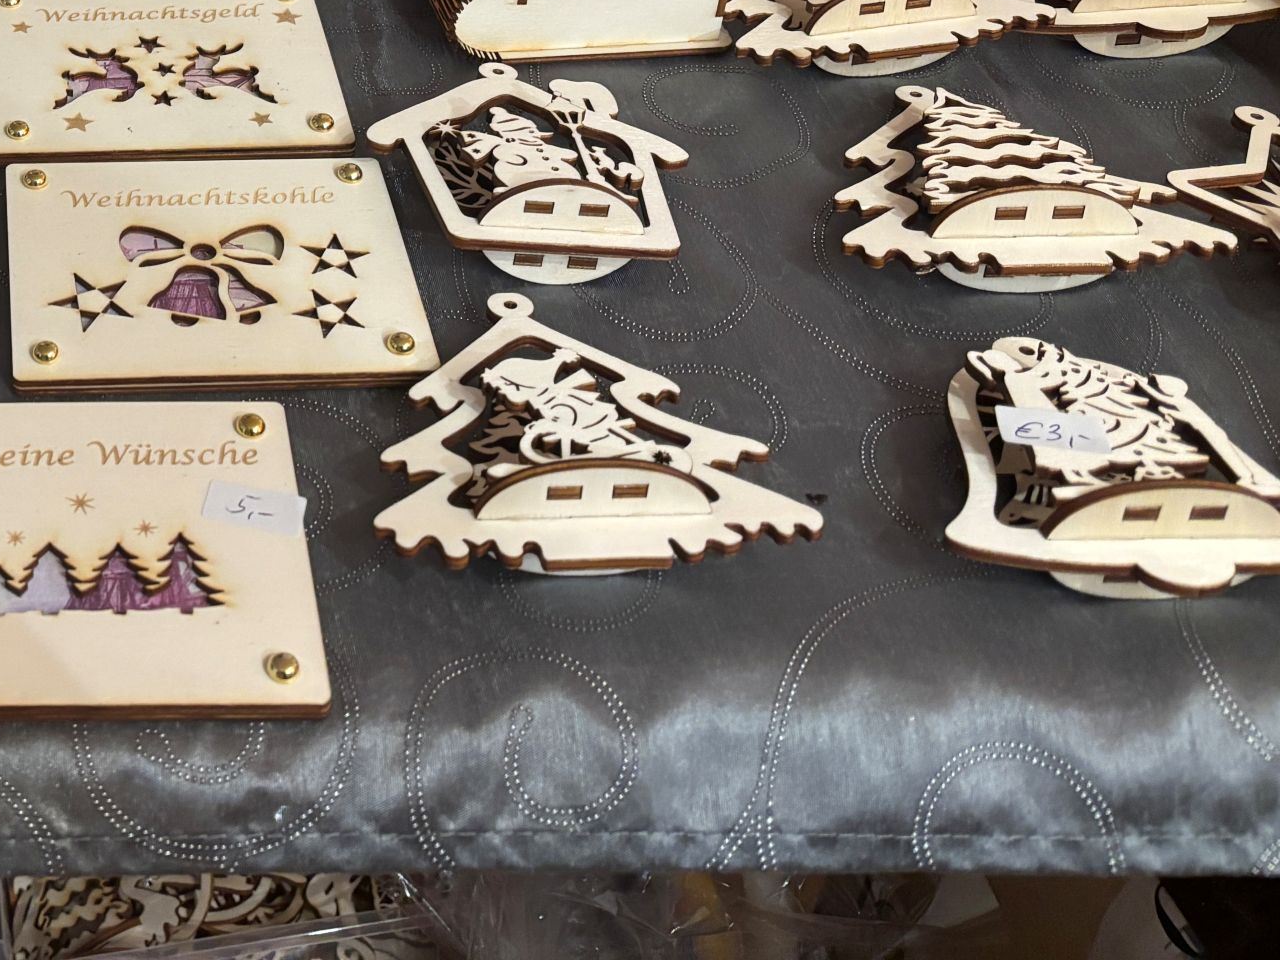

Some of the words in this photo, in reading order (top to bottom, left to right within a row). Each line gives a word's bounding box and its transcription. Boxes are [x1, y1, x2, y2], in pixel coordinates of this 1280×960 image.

[34, 3, 261, 25] Weihnachtsgeld
[60, 187, 336, 210] Weihnachtskohle
[1014, 421, 1091, 449] €3,-
[87, 440, 259, 468] Wünsche
[224, 494, 274, 521] 5,-
